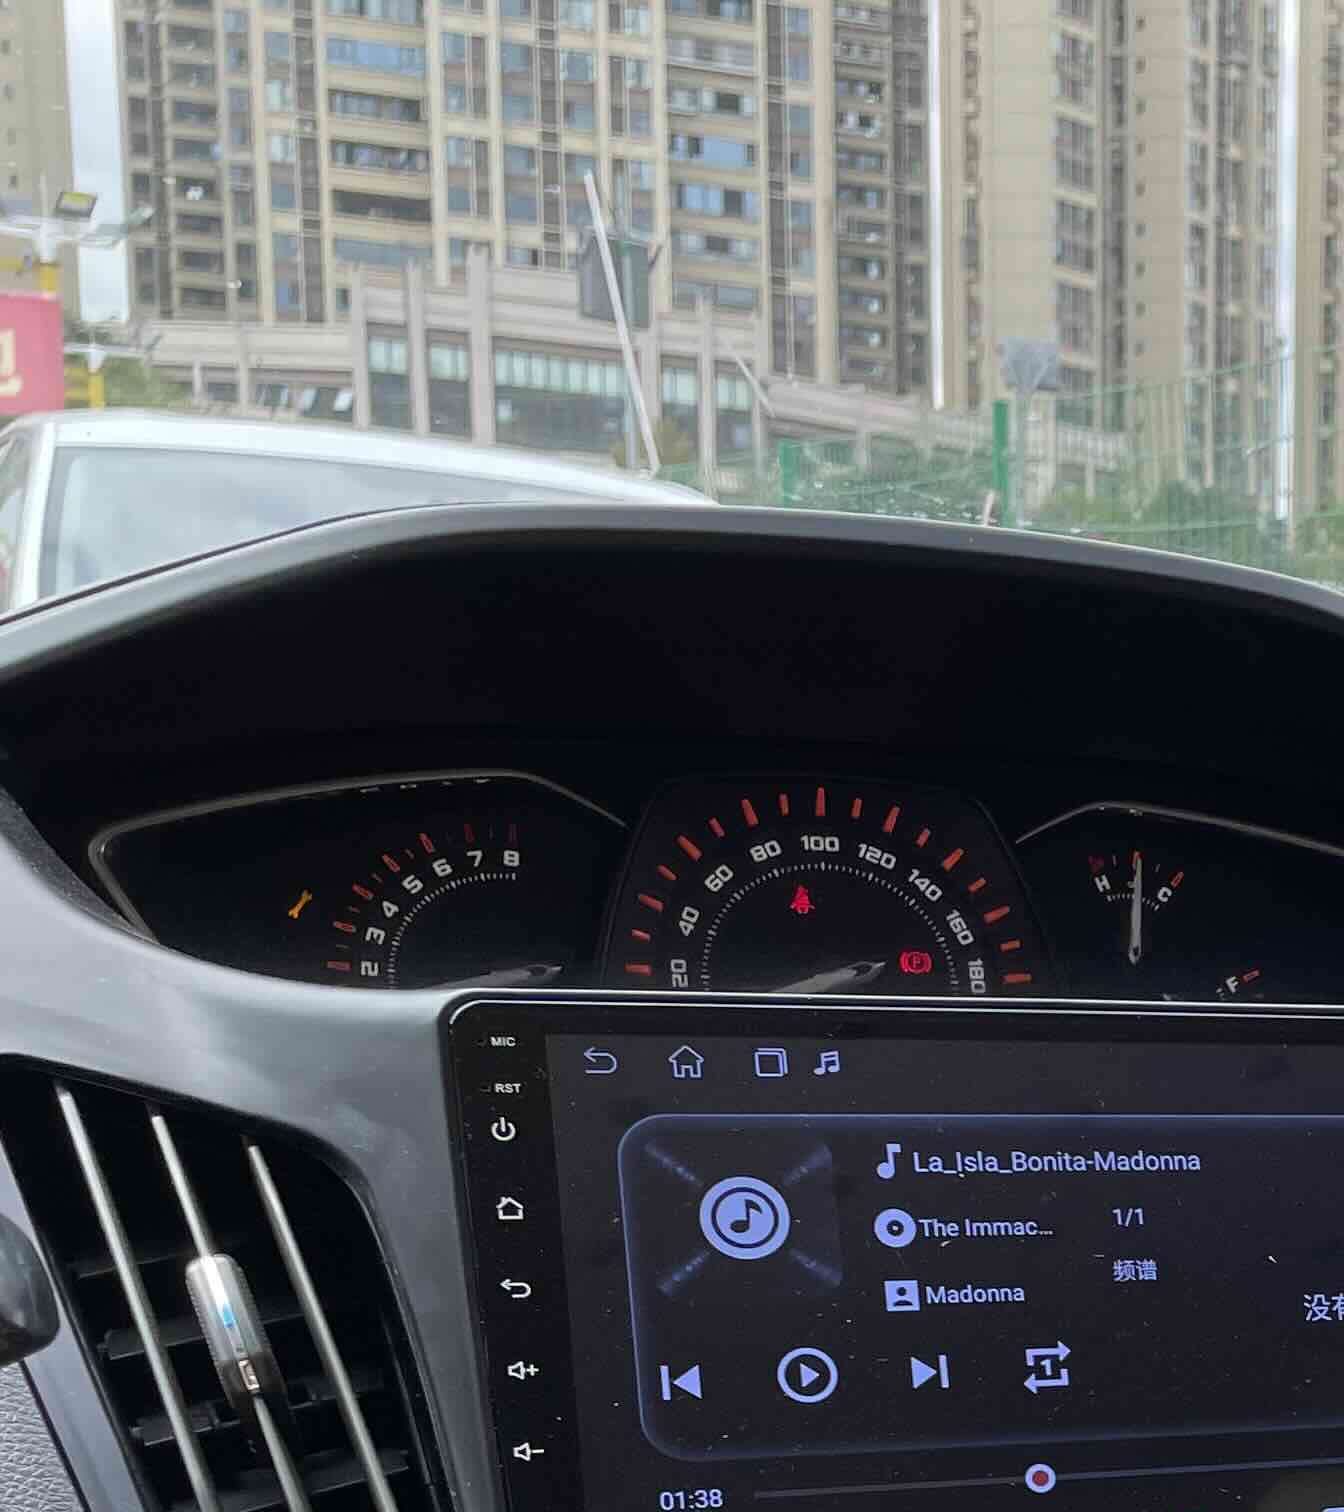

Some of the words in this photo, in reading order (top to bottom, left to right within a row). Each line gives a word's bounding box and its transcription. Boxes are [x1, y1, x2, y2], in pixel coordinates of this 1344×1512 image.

[749, 839, 783, 864] 80
[800, 834, 840, 854] 100
[466, 850, 484, 868] 7
[503, 849, 520, 868] 8
[857, 842, 897, 871] 120
[432, 858, 453, 878] 6
[705, 864, 734, 893] 60
[402, 873, 424, 895] 5
[907, 868, 943, 902] 140
[1093, 874, 1112, 893] H
[1157, 886, 1173, 903] C
[381, 899, 400, 919] 4
[678, 906, 700, 936] 40
[945, 908, 975, 946] 160
[365, 927, 386, 945] 3
[360, 960, 379, 978] 2
[670, 958, 690, 989] 20
[967, 957, 987, 995] 180
[1225, 976, 1241, 994] F
[490, 1036, 516, 1047] MIC
[495, 1083, 521, 1094] RST
[913, 1150, 1201, 1175] La_Isla_Bonita-Madonna
[919, 1219, 960, 1237] The
[1112, 1208, 1145, 1227] 1/1
[1112, 1259, 1158, 1282] 频谱
[925, 1285, 1025, 1305] Madonna
[659, 1489, 724, 1511] 01:38
